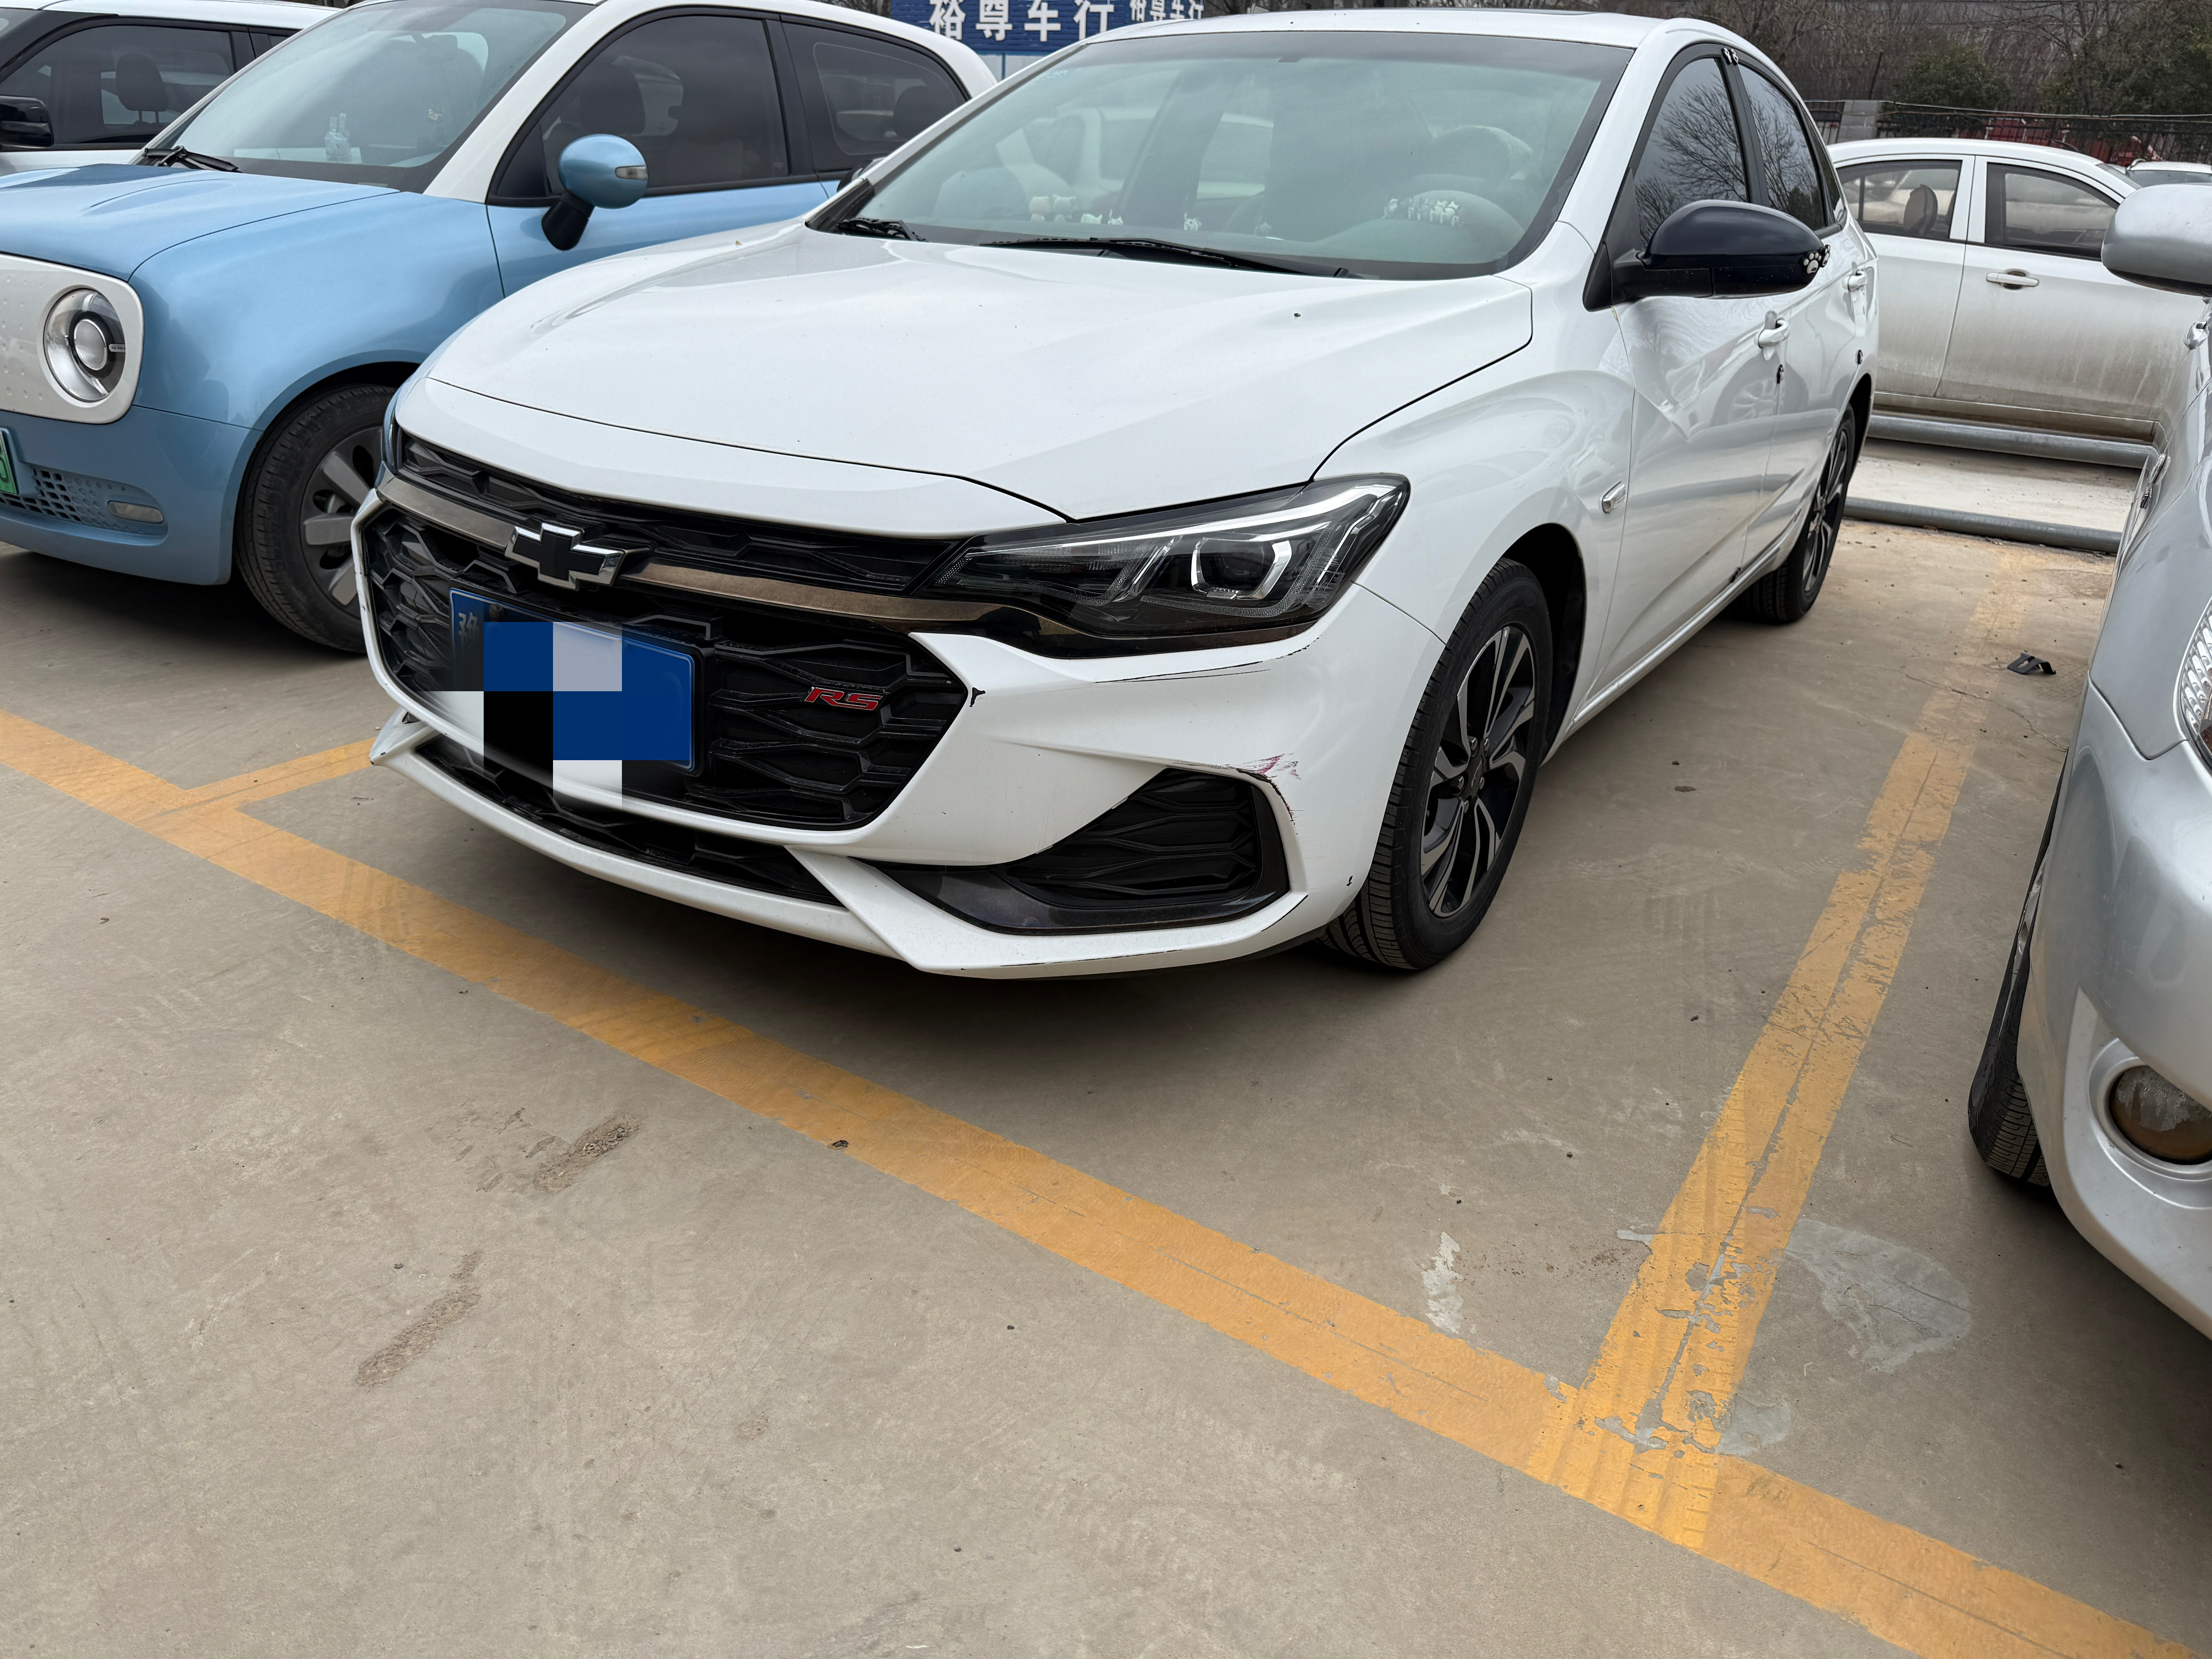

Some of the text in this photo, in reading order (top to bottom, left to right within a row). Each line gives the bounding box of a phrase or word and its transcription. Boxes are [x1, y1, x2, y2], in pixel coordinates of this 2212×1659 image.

[929, 0, 1115, 42] 裕尊车行
[805, 687, 883, 710] RS
